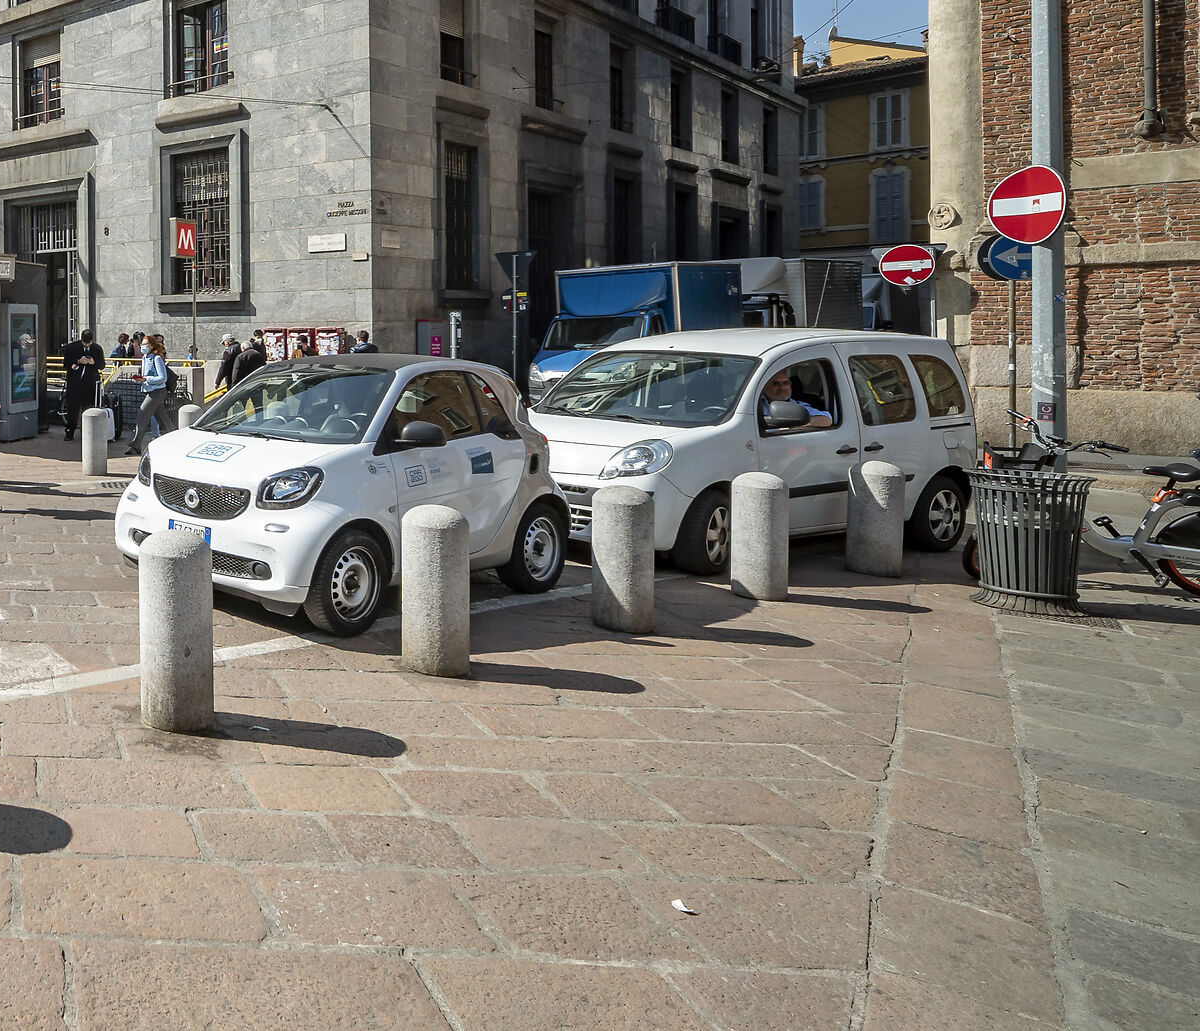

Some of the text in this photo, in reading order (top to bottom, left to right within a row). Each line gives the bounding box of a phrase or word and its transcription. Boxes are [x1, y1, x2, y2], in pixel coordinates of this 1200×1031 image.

[177, 228, 195, 250] M
[409, 468, 423, 477] CAR
[410, 475, 424, 483] 2GO
